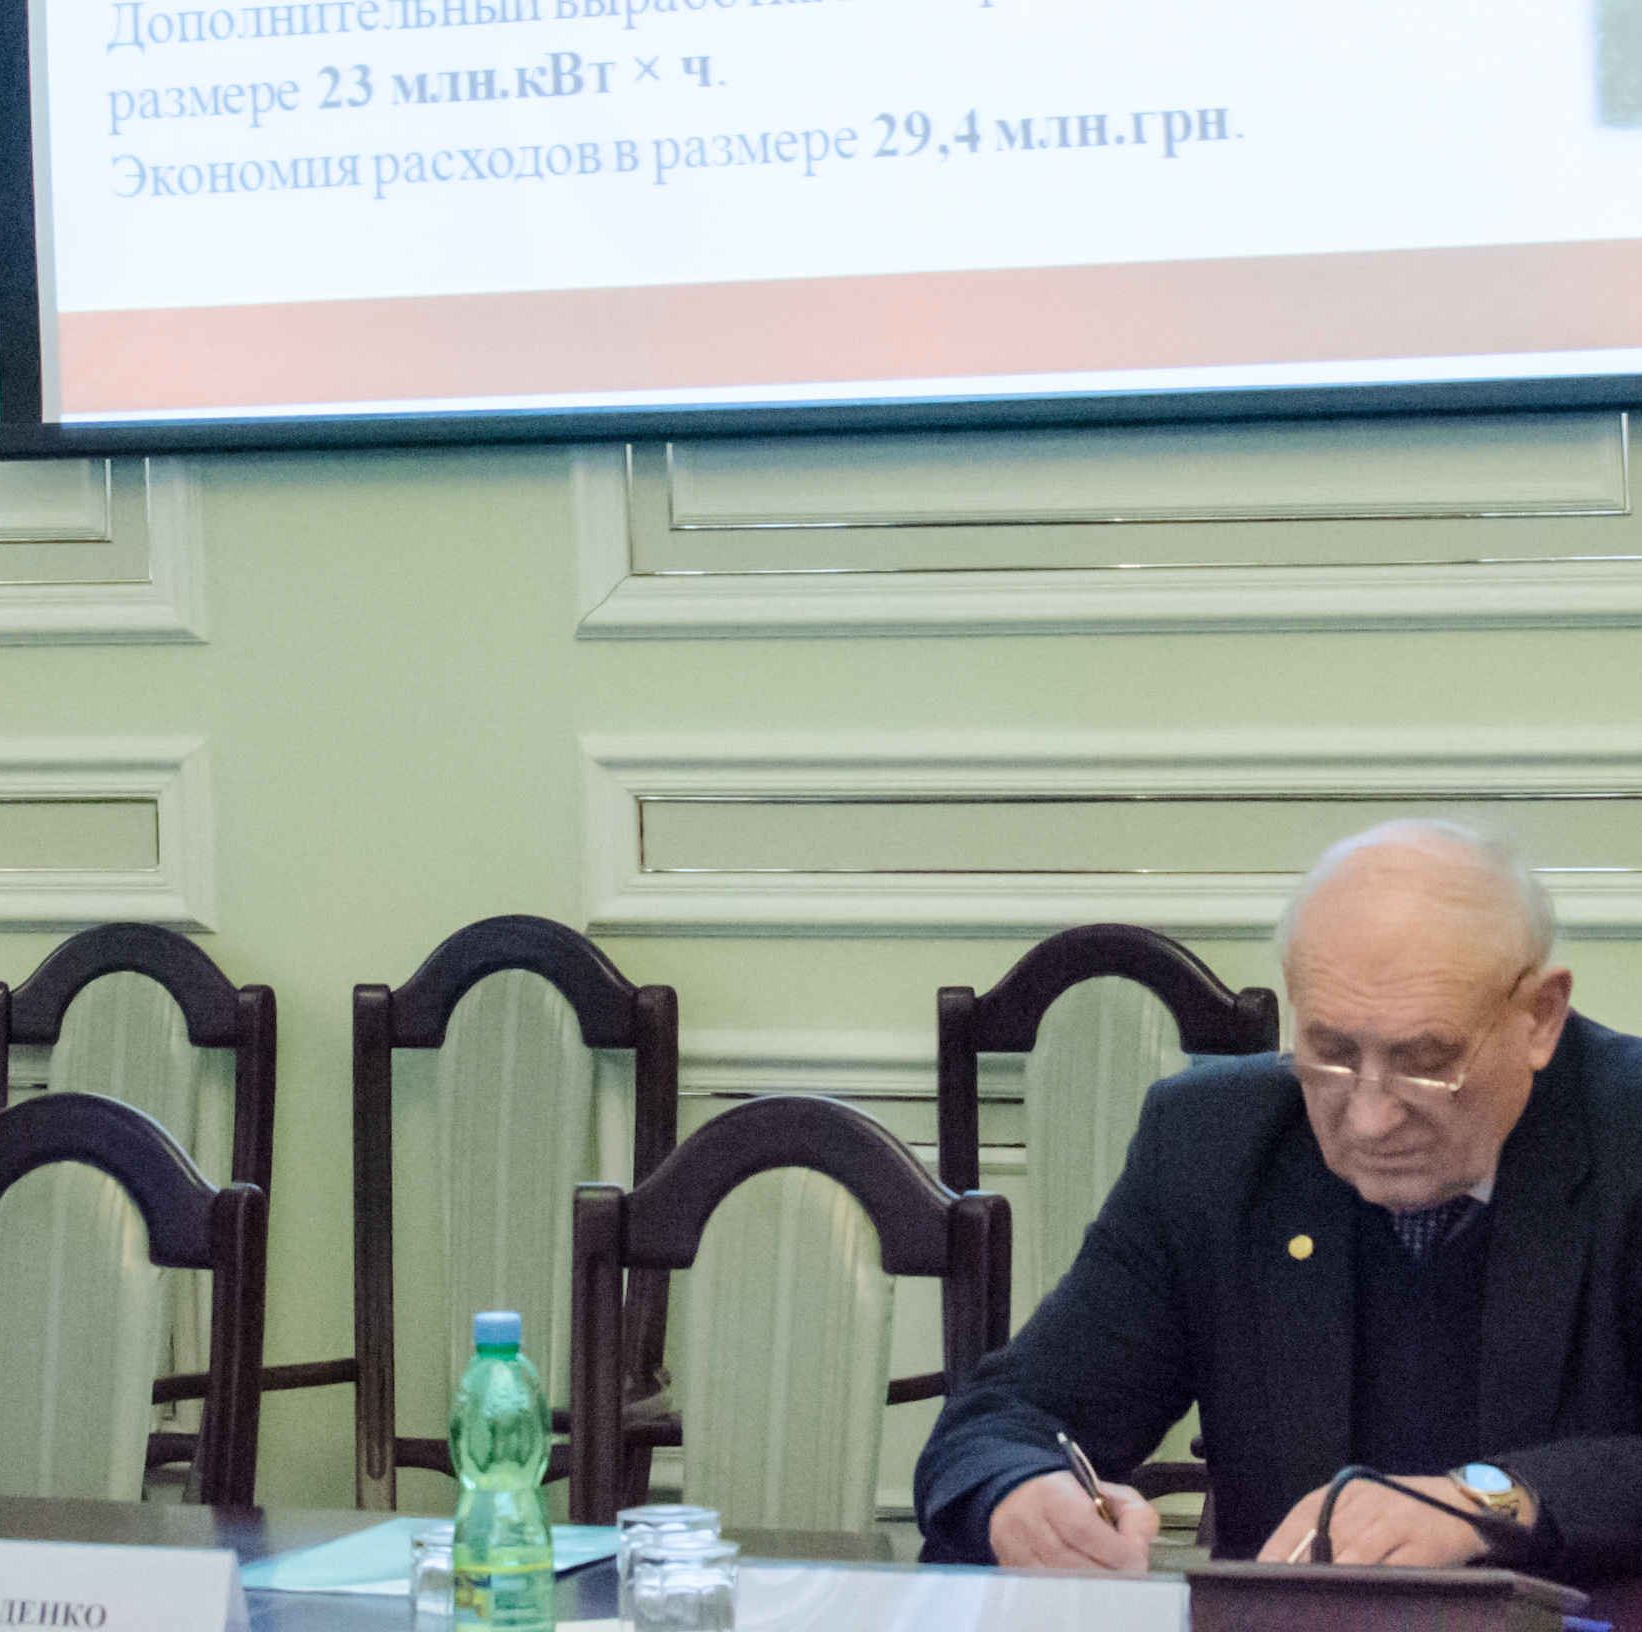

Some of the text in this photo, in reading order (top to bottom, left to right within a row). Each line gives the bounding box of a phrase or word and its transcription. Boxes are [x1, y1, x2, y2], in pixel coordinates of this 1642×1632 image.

[105, 78, 303, 139] размере
[316, 60, 377, 112] 23
[389, 48, 618, 108] млн.кВт
[109, 151, 364, 200] Экономия
[369, 139, 606, 203] расходов
[611, 137, 643, 175] в
[649, 125, 861, 188] размере
[871, 106, 985, 164] 29,4
